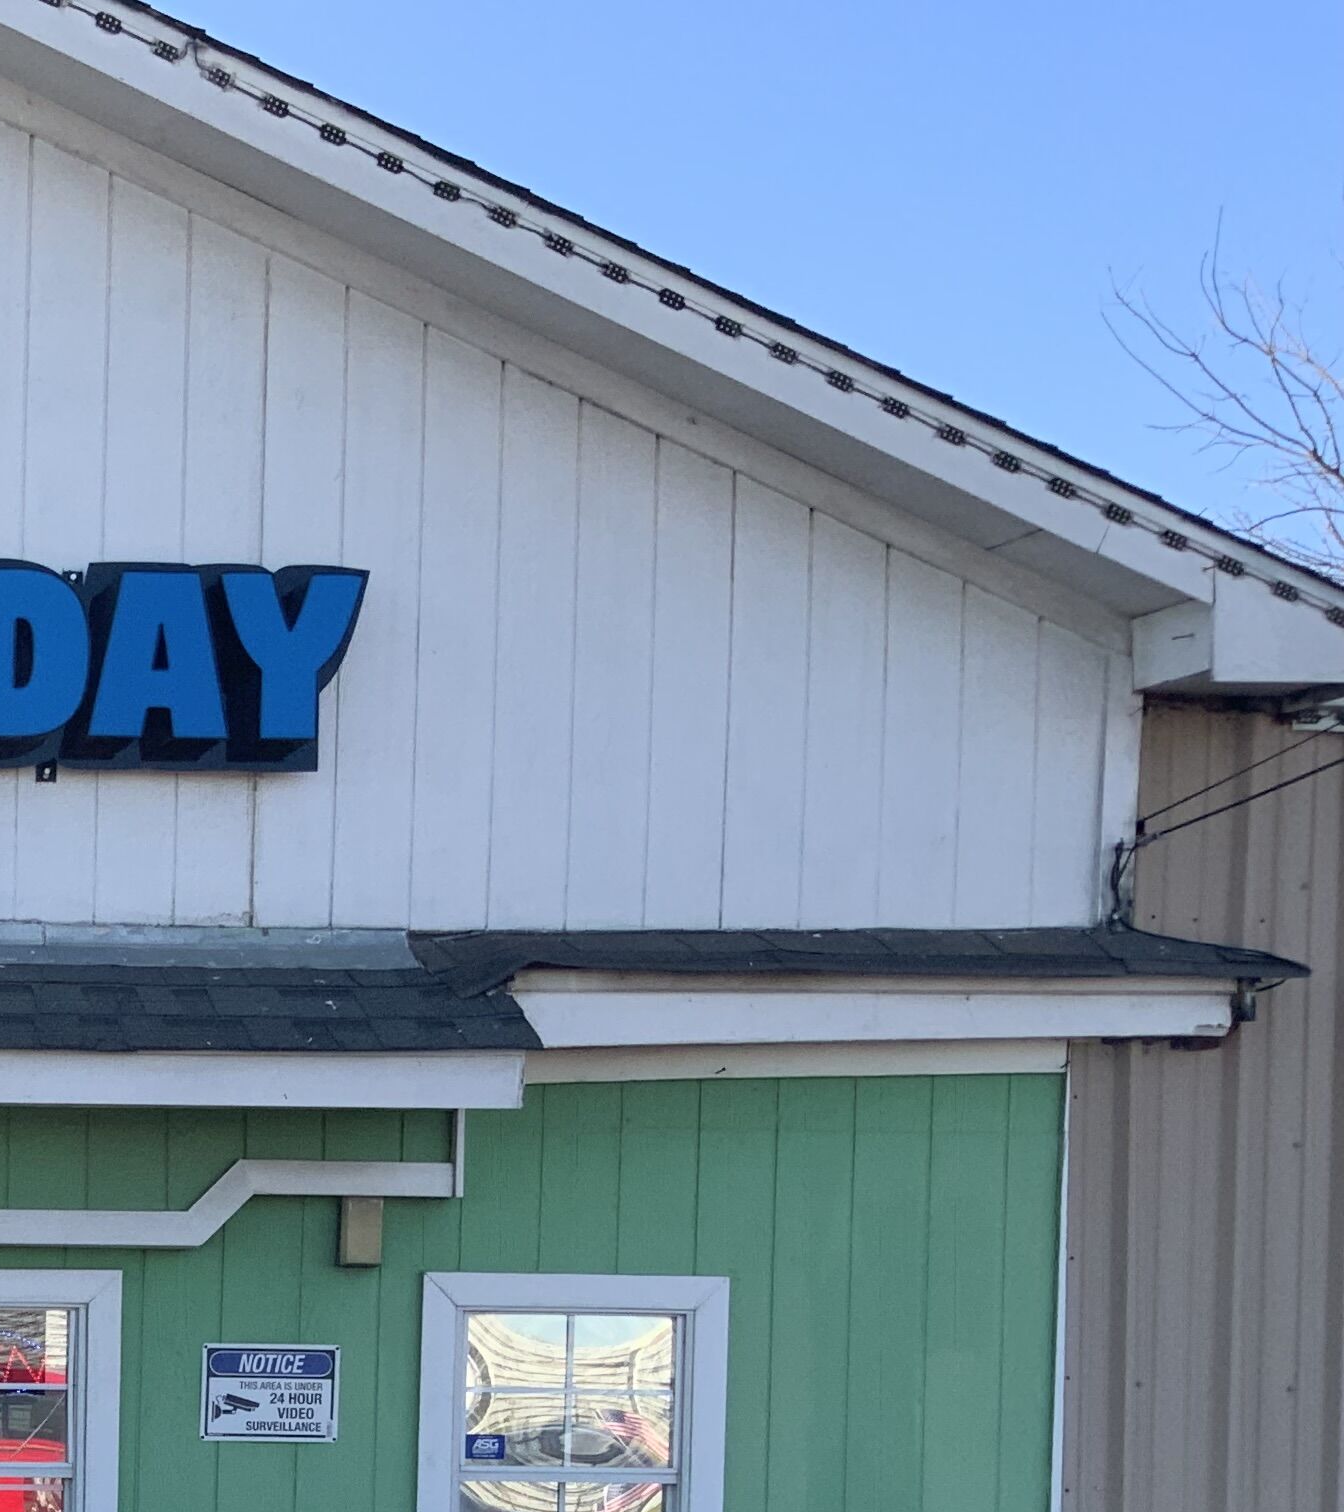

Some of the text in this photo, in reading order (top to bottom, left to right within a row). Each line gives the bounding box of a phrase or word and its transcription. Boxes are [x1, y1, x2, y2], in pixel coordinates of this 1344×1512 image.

[238, 1353, 306, 1374] NOTICE
[240, 1381, 323, 1391] THIS AREA IS UNDER
[269, 1393, 322, 1404] 24 HOUR
[277, 1407, 314, 1419] VIDEO
[245, 1421, 322, 1432] SURVEILLANCE
[472, 1438, 500, 1451] ASG
